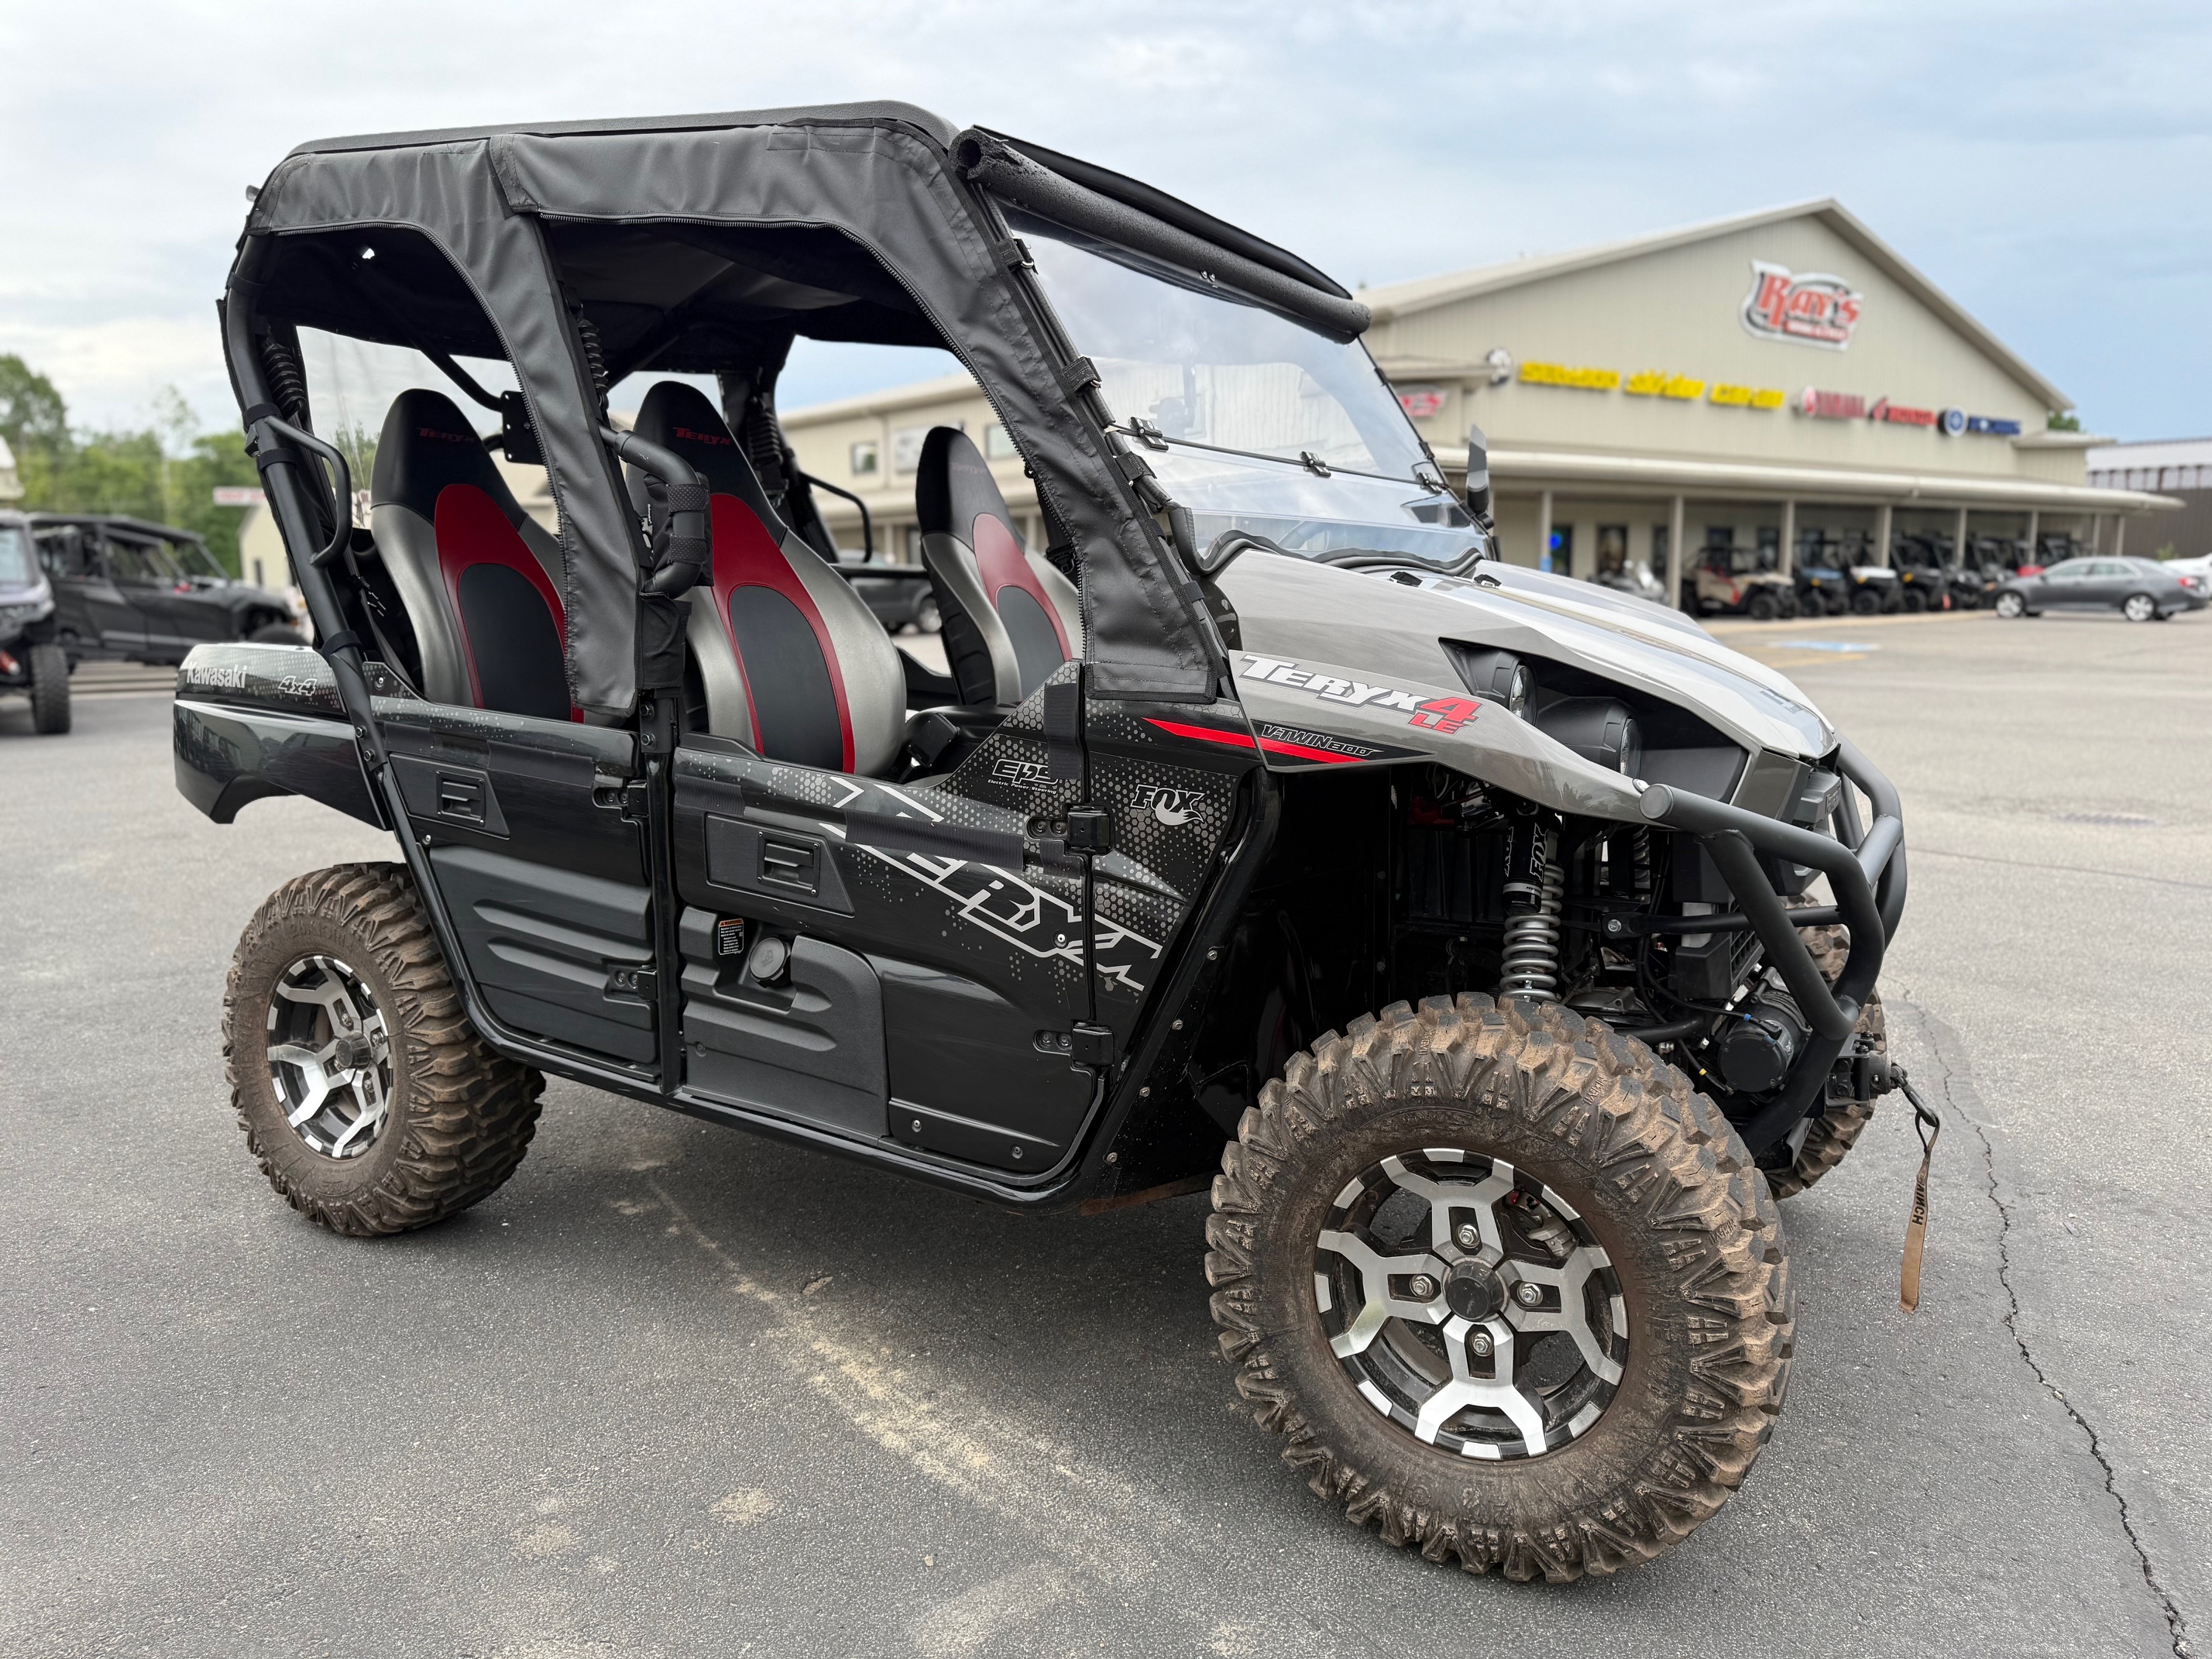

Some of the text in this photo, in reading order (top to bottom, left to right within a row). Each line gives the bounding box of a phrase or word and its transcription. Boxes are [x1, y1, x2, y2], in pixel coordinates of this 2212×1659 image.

[186, 661, 248, 689] Kawasaki
[277, 675, 318, 696] 4x4
[1408, 713, 1466, 734] LE
[988, 778, 1009, 787] Electric
[1031, 786, 1057, 795] Steering
[1131, 784, 1206, 824] FOX
